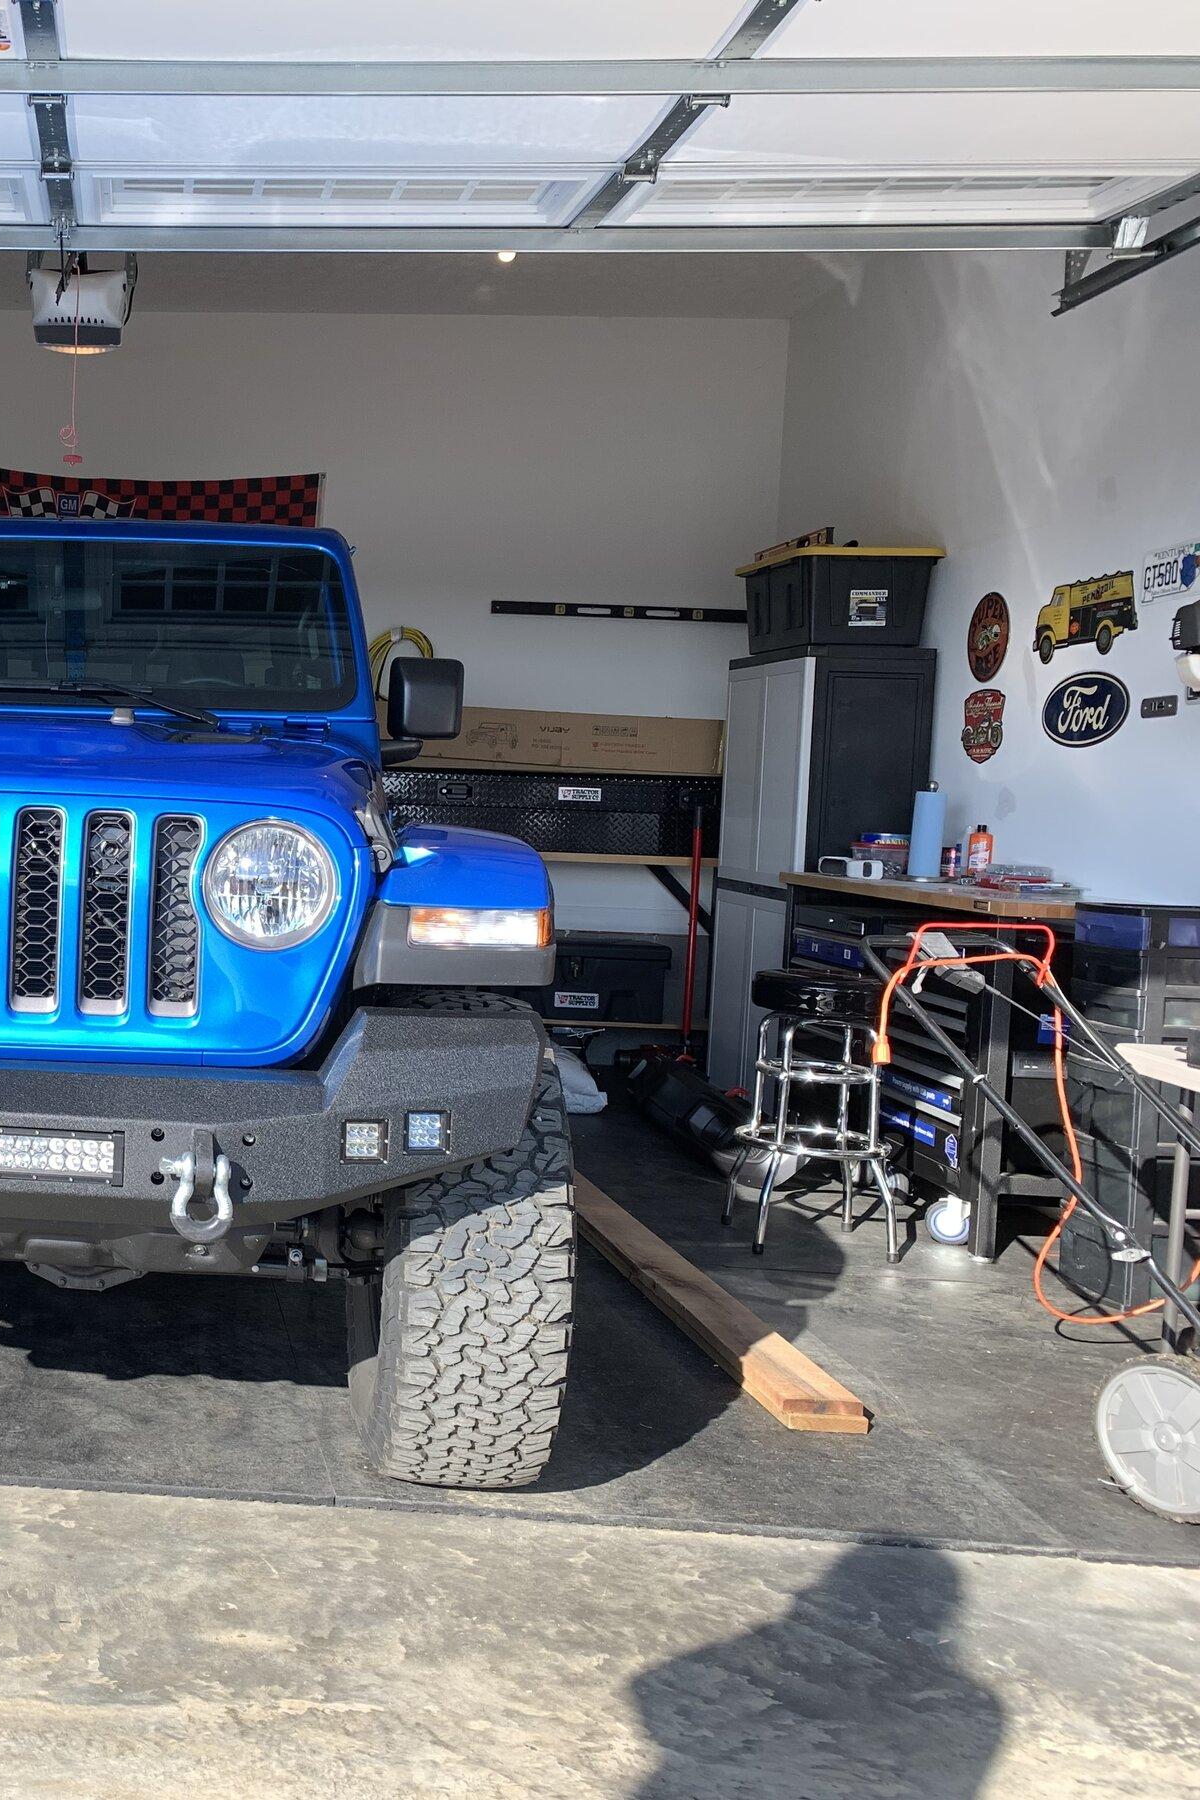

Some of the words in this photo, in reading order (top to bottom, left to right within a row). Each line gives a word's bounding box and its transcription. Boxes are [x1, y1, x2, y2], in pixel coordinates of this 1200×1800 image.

[60, 498, 77, 511] GM
[1143, 559, 1179, 590] GT500
[1057, 685, 1112, 734] Ford
